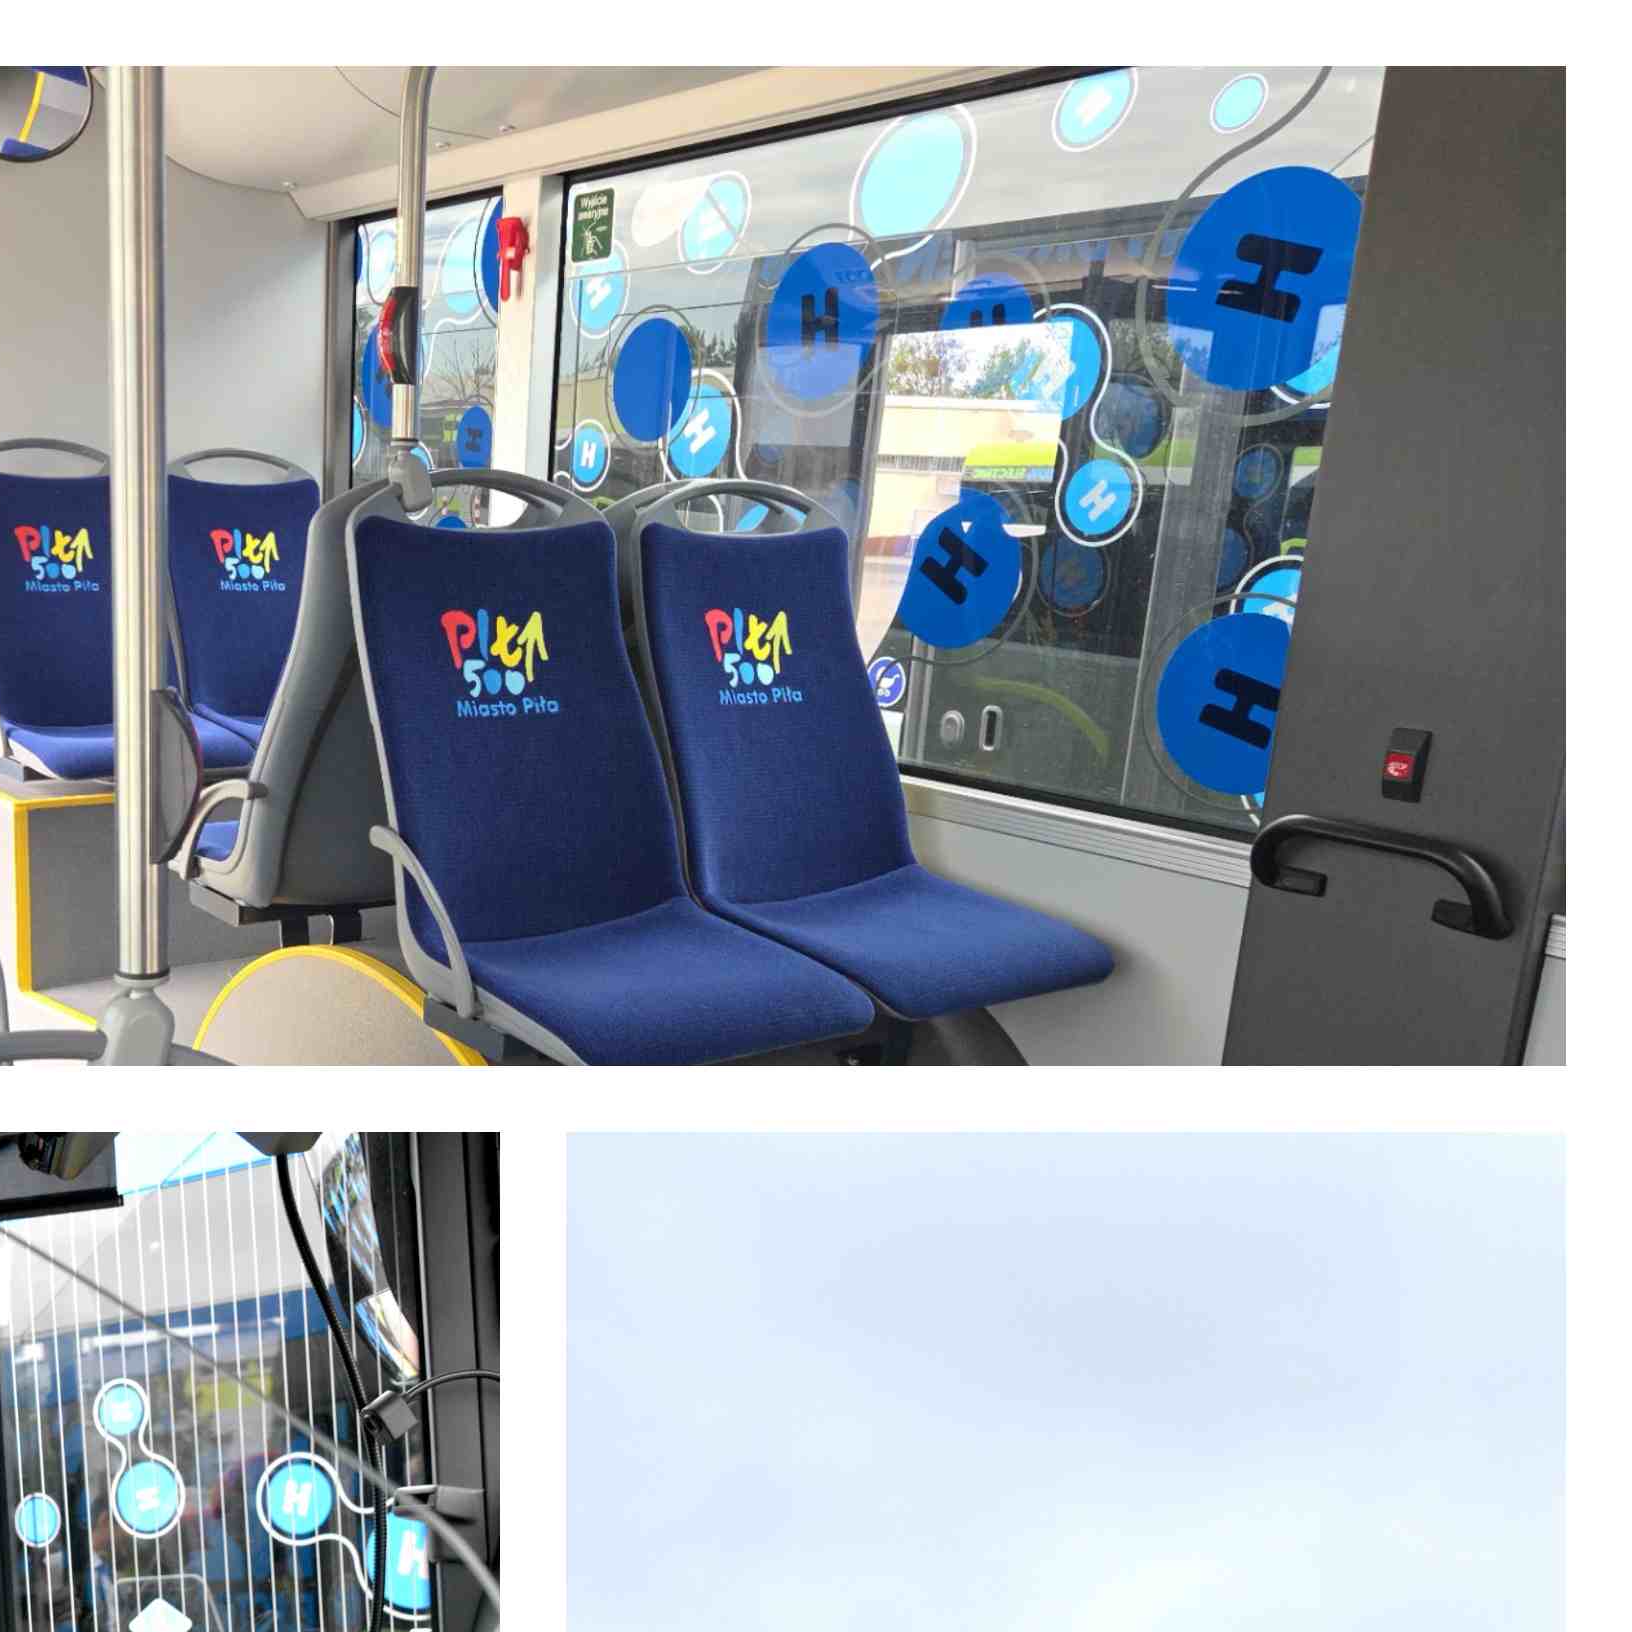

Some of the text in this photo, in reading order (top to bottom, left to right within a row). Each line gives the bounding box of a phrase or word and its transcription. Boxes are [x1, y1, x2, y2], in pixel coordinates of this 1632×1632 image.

[25, 579, 70, 593] Miasto
[220, 579, 259, 592] Miasto
[719, 689, 768, 704] Miasto
[456, 696, 559, 717] Miasto Piła
